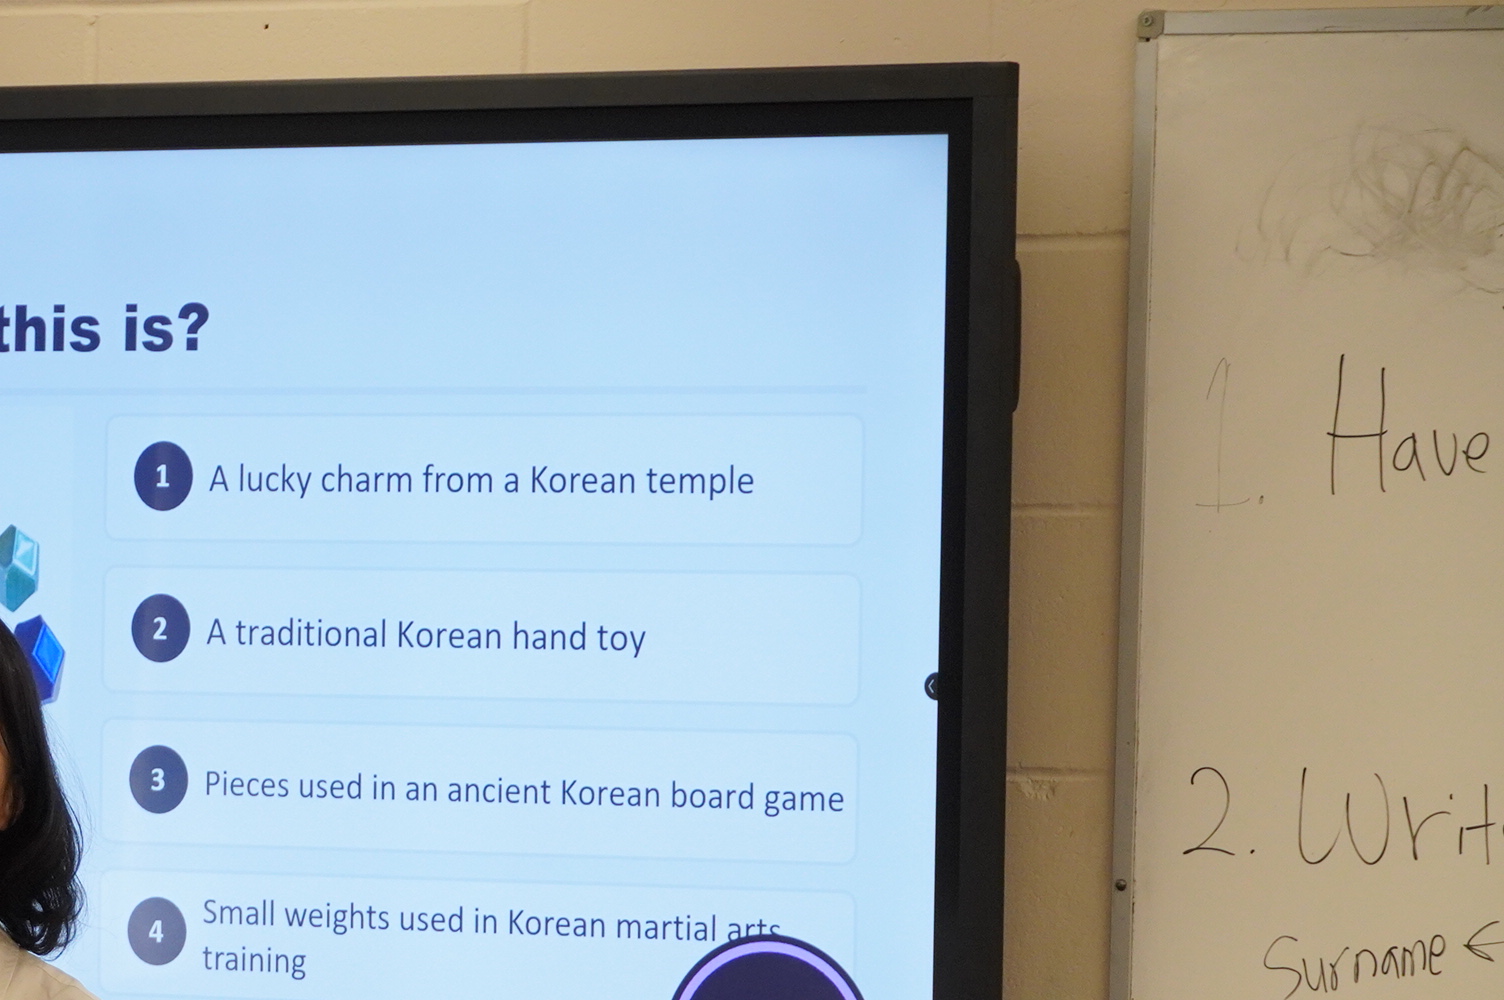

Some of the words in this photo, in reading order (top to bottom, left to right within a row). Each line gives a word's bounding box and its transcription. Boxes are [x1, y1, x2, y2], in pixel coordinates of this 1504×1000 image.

[124, 301, 209, 352] is?
[1327, 354, 1490, 495] Have
[155, 465, 170, 488] 1
[209, 465, 229, 494] A
[239, 463, 312, 499] lucky
[321, 463, 413, 495] charm
[422, 463, 494, 495] from
[504, 472, 520, 494] a
[531, 466, 635, 495] Korean
[646, 465, 755, 500] temple
[152, 617, 168, 640] 2
[206, 618, 227, 646] A
[235, 617, 388, 649] traditional
[398, 620, 502, 650] Korean
[513, 621, 587, 652] hand
[597, 626, 646, 659] toy
[150, 768, 165, 792] 3
[206, 770, 289, 799] Pieces
[299, 771, 363, 801] used
[373, 772, 396, 800] in
[406, 779, 438, 802] an
[447, 776, 551, 805] ancient
[561, 780, 661, 809] Korean
[671, 781, 754, 811] board
[764, 789, 845, 818] game
[1183, 766, 1255, 856] 2.
[1299, 766, 1504, 865] Writ
[148, 920, 164, 944] 4
[203, 900, 276, 928] Small
[285, 902, 389, 938] weights
[399, 906, 464, 934] used
[473, 907, 497, 934] in
[508, 910, 606, 939] Korean
[616, 912, 716, 942] martial
[727, 919, 781, 941] arts
[202, 946, 306, 980] training
